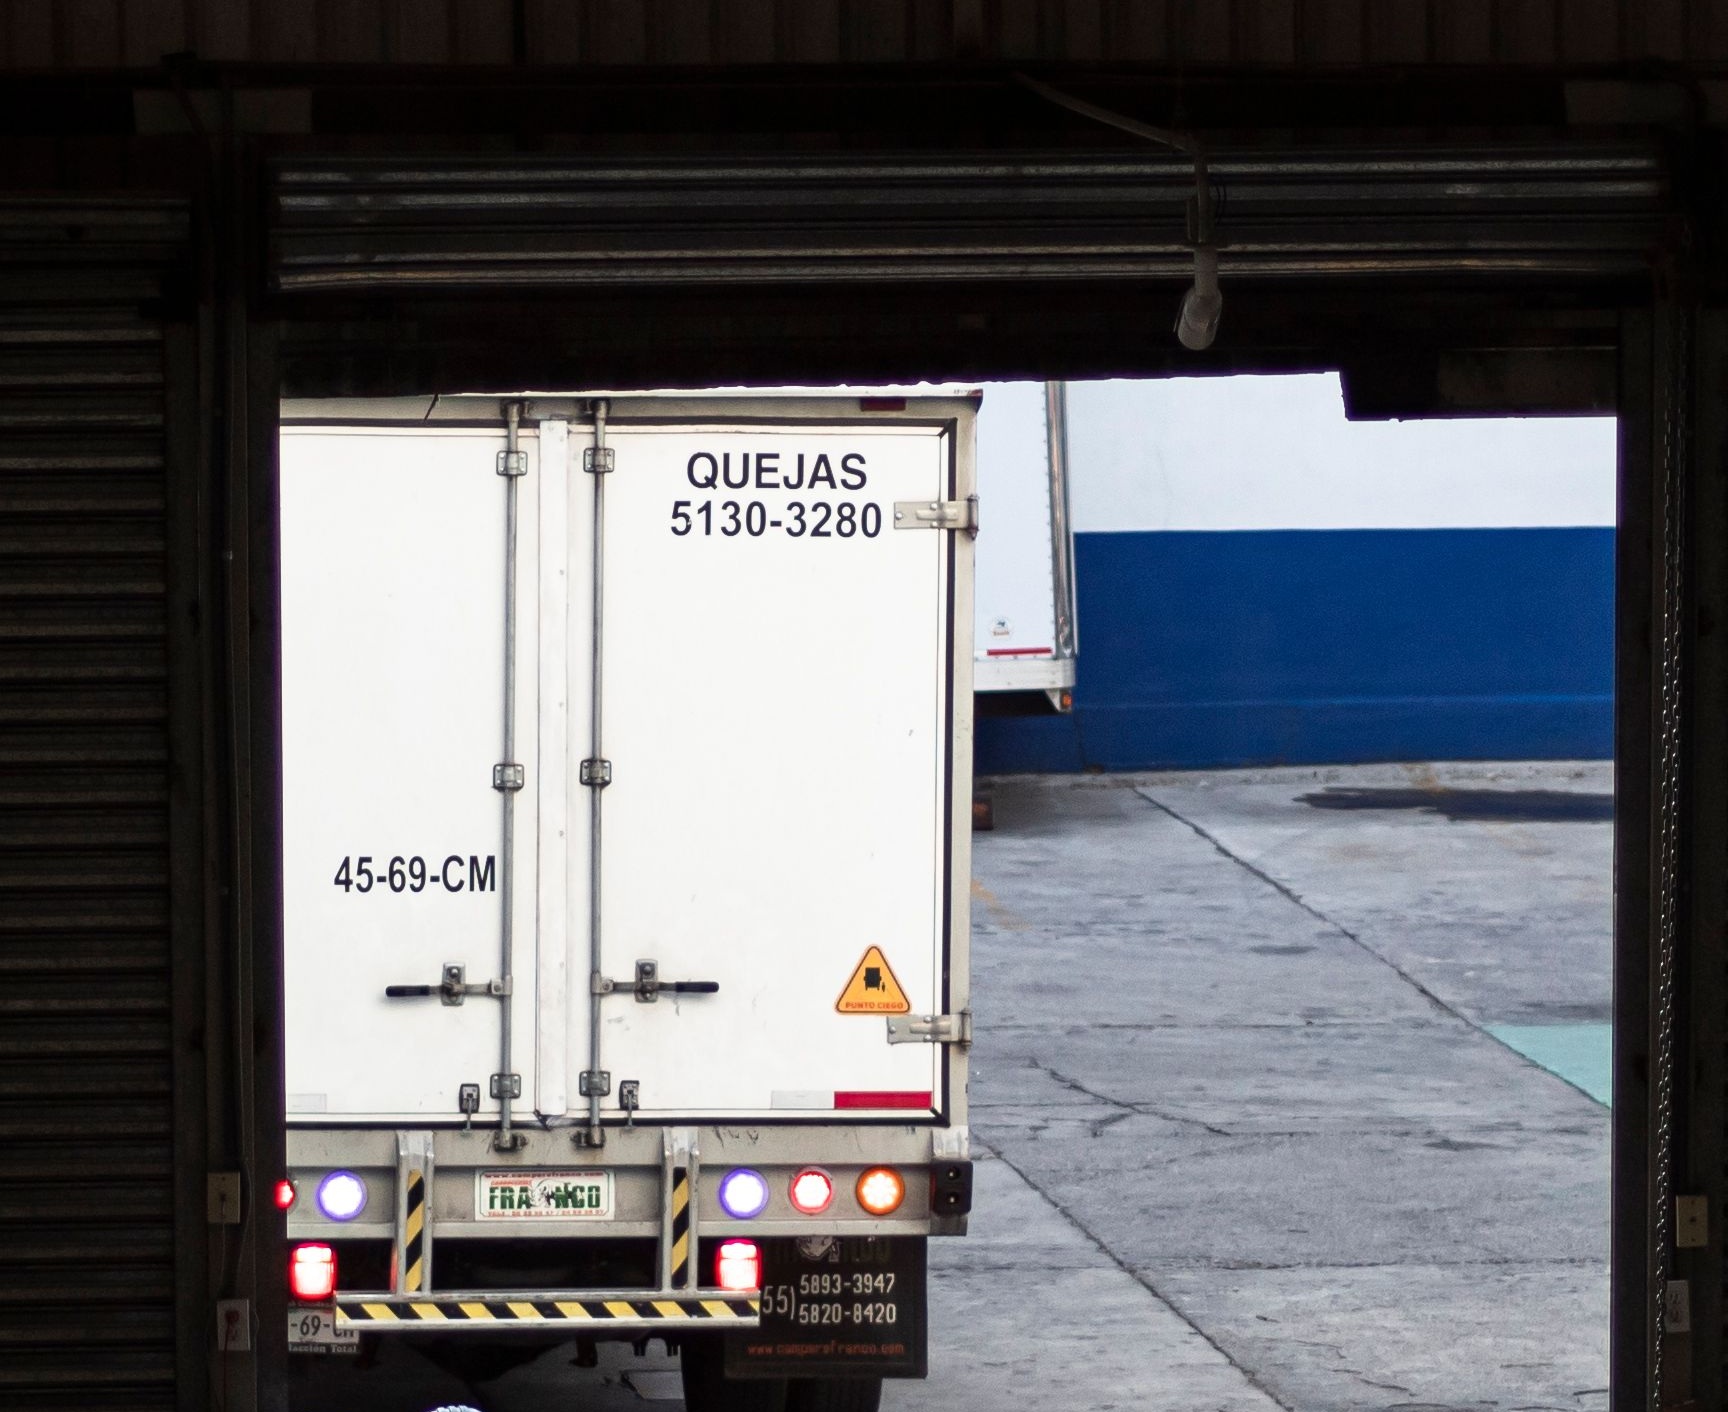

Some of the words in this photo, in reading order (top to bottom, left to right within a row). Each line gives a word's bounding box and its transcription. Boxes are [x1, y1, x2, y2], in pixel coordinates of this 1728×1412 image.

[686, 452, 868, 491] QUEJAS
[670, 500, 883, 538] 5130-3280
[333, 855, 496, 893] 45-69-CM
[799, 1273, 896, 1295] 5893-3947
[761, 1285, 796, 1320] 55)
[798, 1303, 897, 1324] 5820-8420
